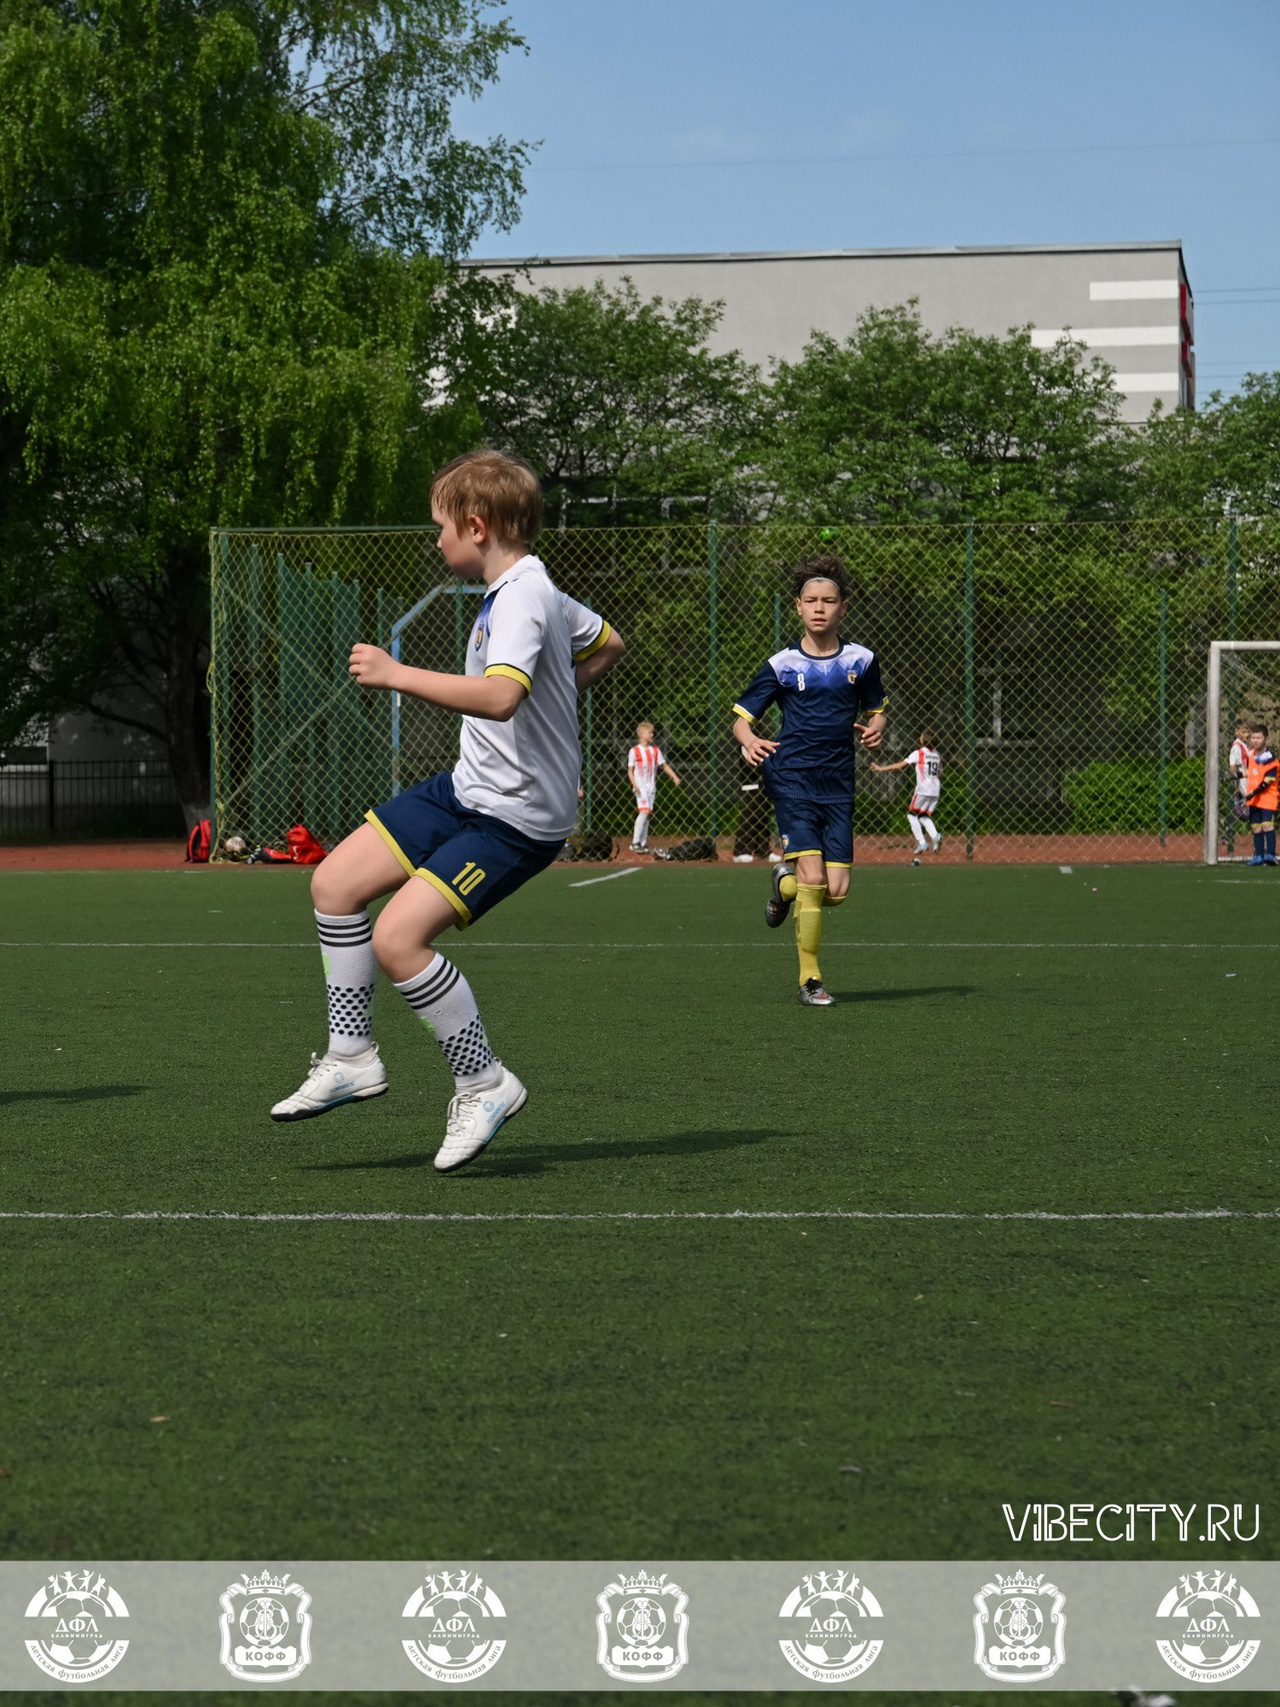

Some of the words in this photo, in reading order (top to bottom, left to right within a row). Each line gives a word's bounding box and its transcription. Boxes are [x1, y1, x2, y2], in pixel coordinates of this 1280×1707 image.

[797, 673, 805, 691] 8
[927, 761, 938, 776] 19
[451, 861, 486, 896] 10
